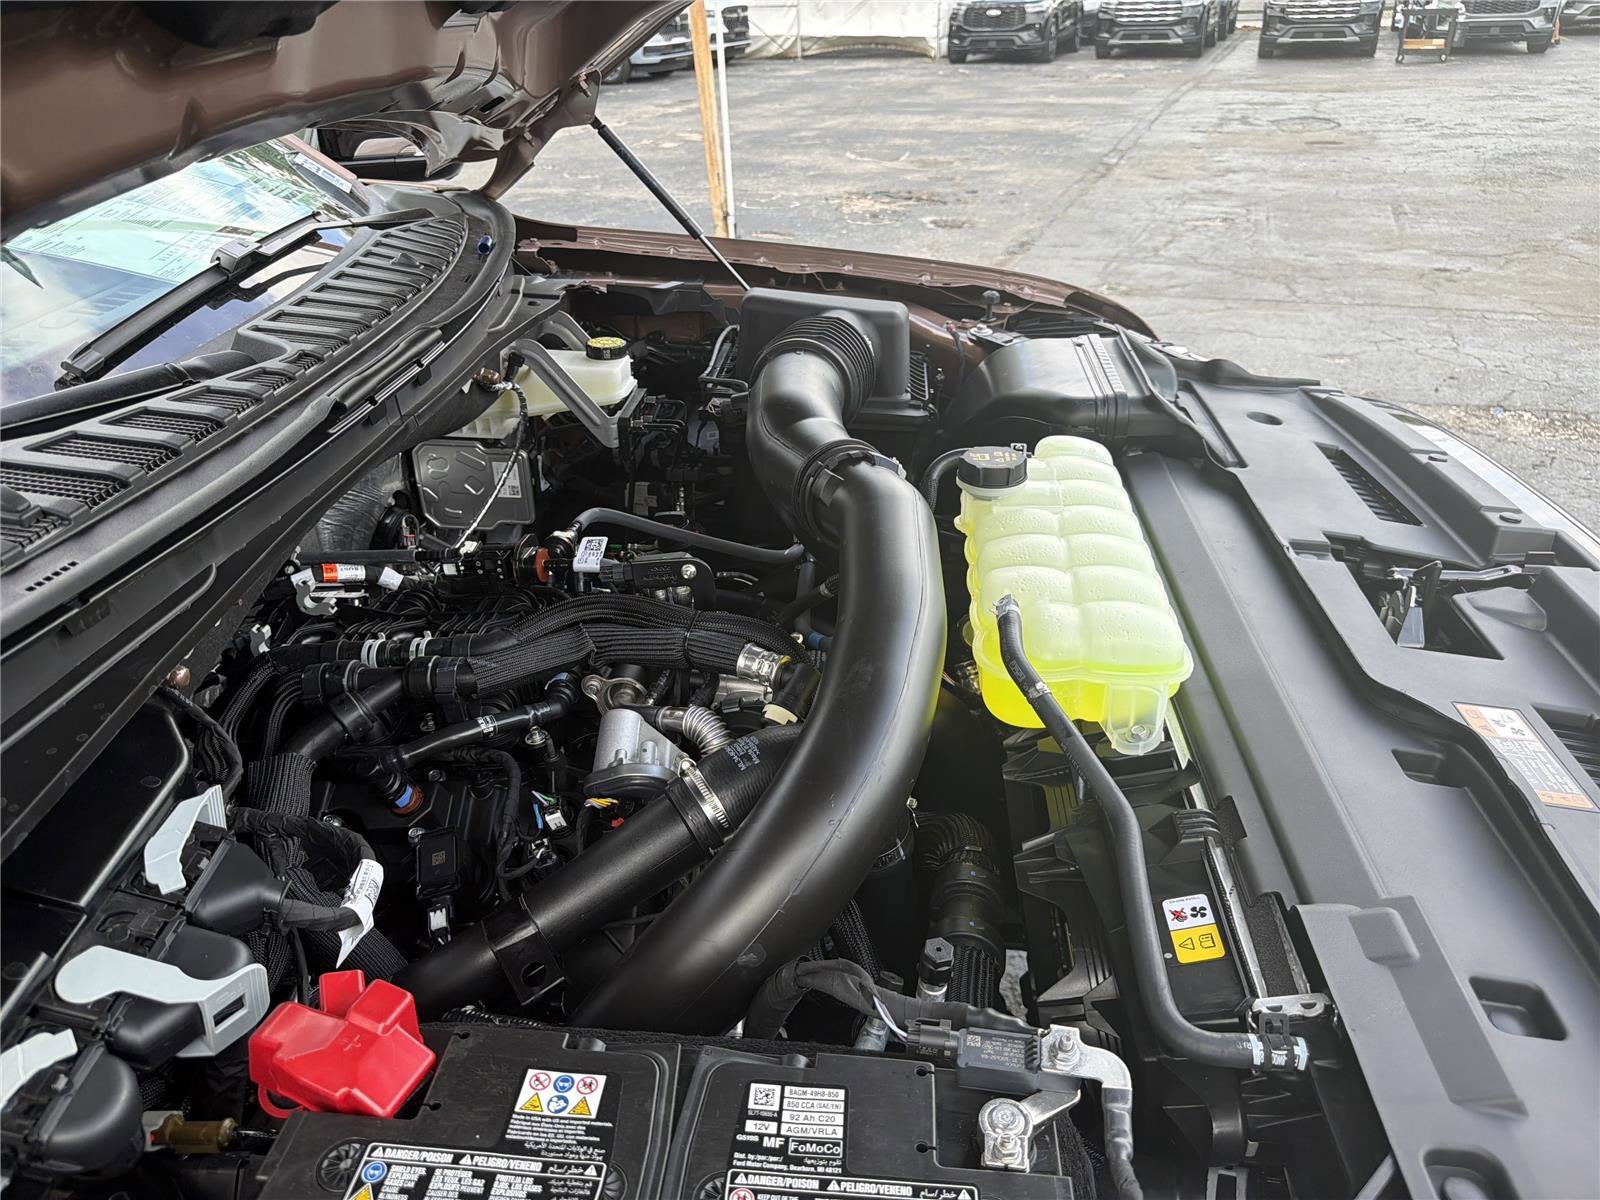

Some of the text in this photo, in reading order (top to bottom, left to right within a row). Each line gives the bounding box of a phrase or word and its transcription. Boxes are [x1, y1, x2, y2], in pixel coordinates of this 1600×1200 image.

[786, 1100, 800, 1108] 850
[800, 1101, 815, 1109] CCA
[789, 1113, 836, 1123] 92 Ah C20
[753, 1122, 771, 1131] 12V
[786, 1126, 838, 1136] AGM/VRLA
[762, 1136, 786, 1148] MF
[790, 1142, 841, 1154] FoMoCo
[385, 1148, 454, 1163] DANGER/POISON
[473, 1156, 543, 1171] PELIGRO/VENENO
[747, 1174, 820, 1190] DANGER/POISON
[840, 1182, 913, 1197] PELIGRO/VENENO
